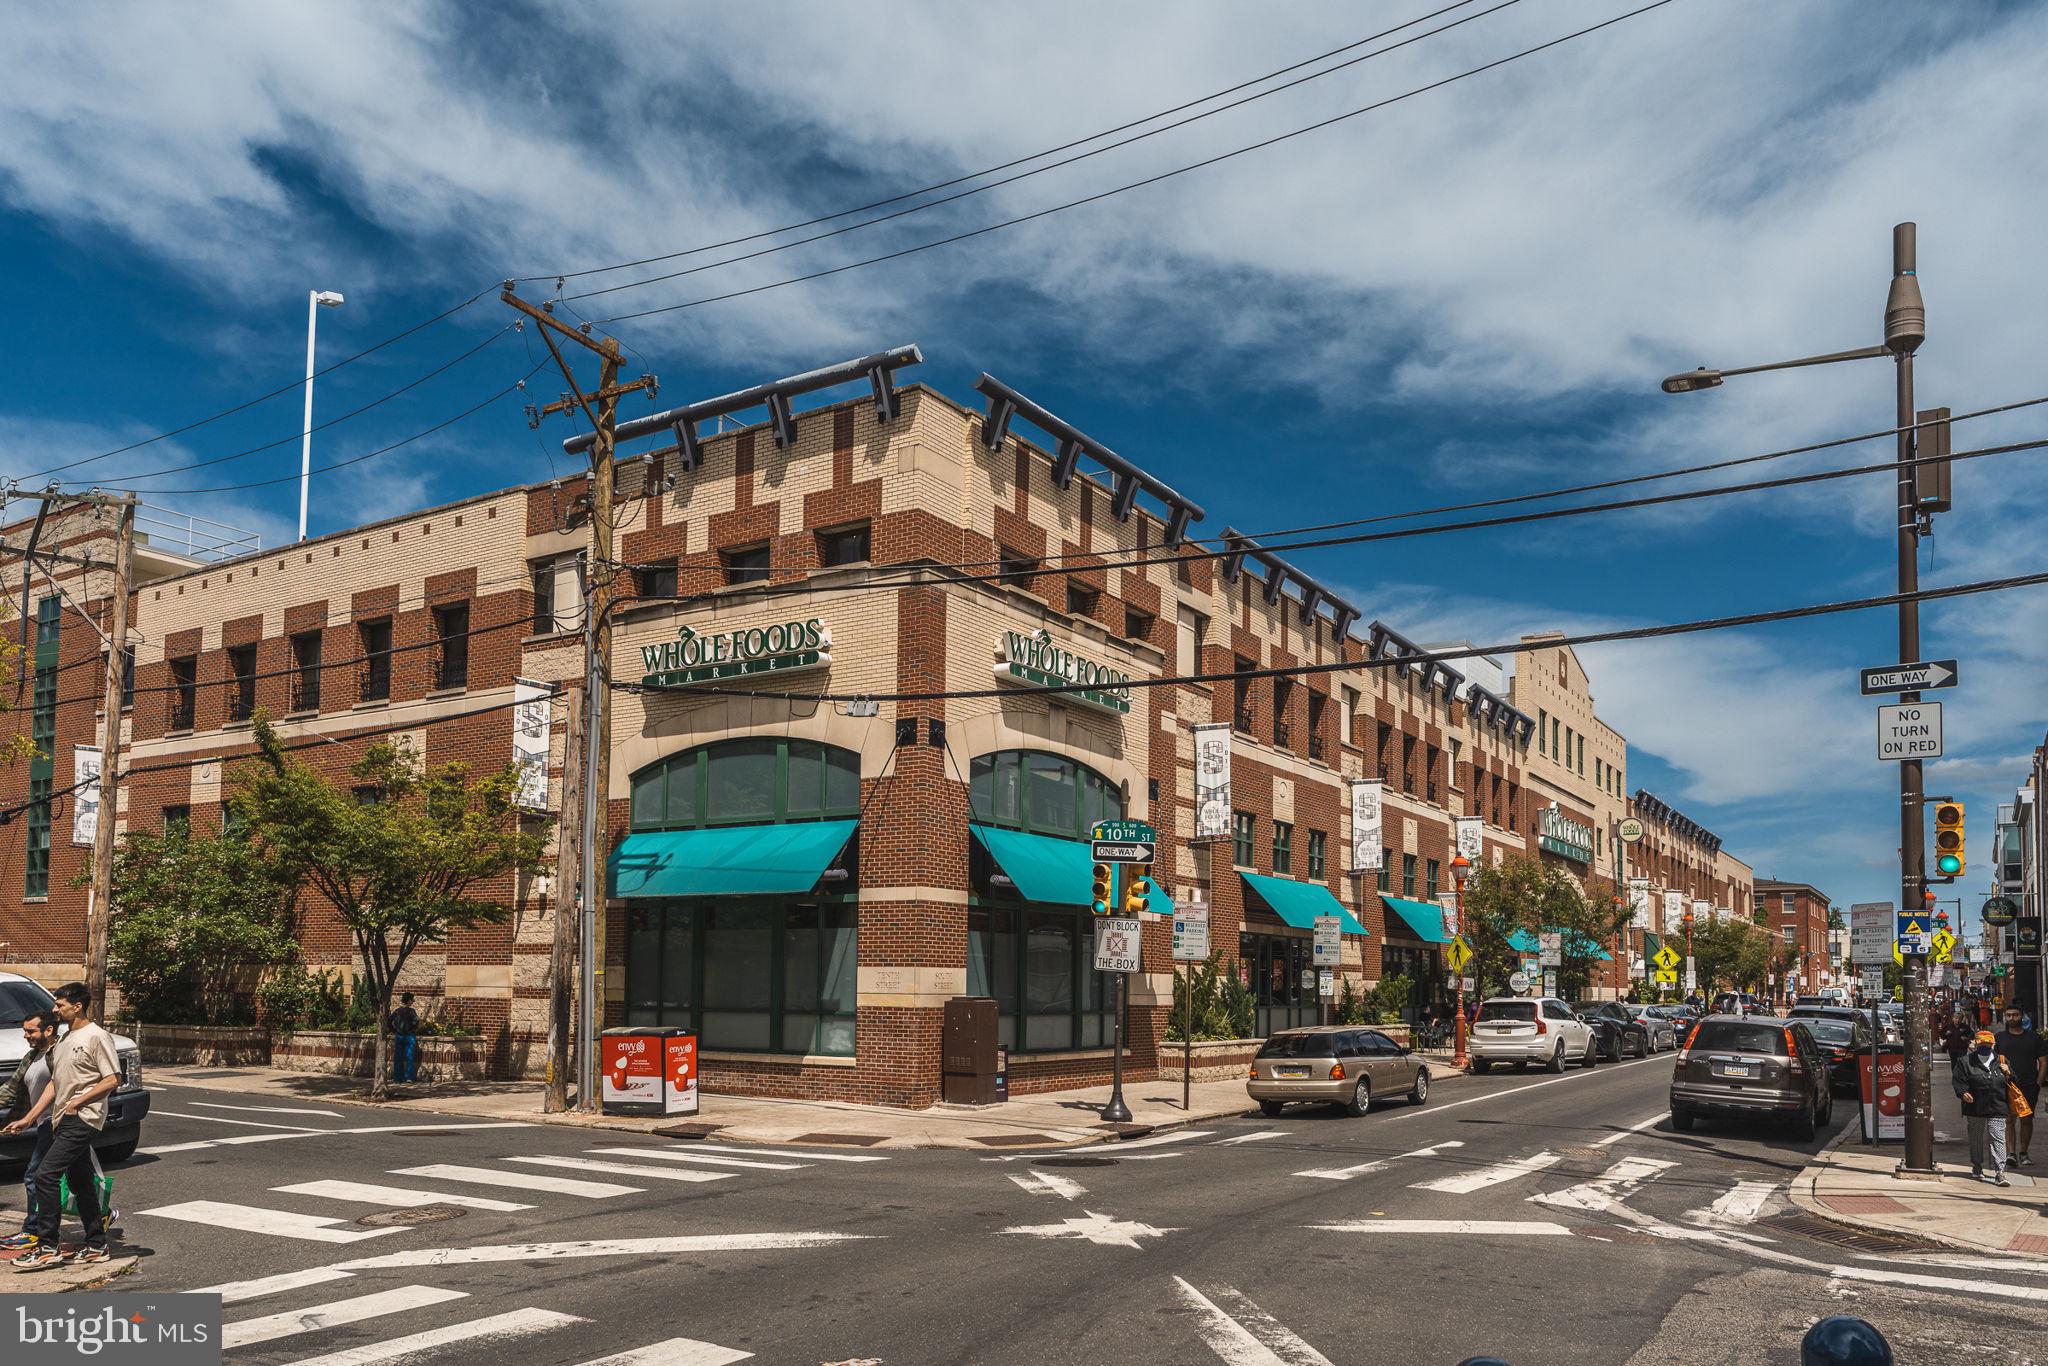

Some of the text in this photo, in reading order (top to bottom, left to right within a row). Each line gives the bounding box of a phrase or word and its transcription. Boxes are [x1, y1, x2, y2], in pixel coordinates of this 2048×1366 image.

[640, 617, 821, 673] WHOLE FOODS
[658, 654, 806, 686] MARKET
[1007, 628, 1130, 699] WHOLE FOODS
[1871, 670, 1928, 687] ONE WAY
[1898, 710, 1921, 721] NO
[1891, 725, 1929, 737] TURN
[1884, 740, 1937, 753] ON RED
[1106, 828, 1151, 842] 10TH ST
[1099, 847, 1136, 856] ONE WAY
[1097, 920, 1139, 932] DONT BLOCK
[1097, 957, 1136, 970] THE BOX
[875, 982, 901, 990] STREET
[617, 1042, 637, 1056] envy
[669, 1046, 686, 1056] envy
[1866, 1064, 1893, 1077] evy
